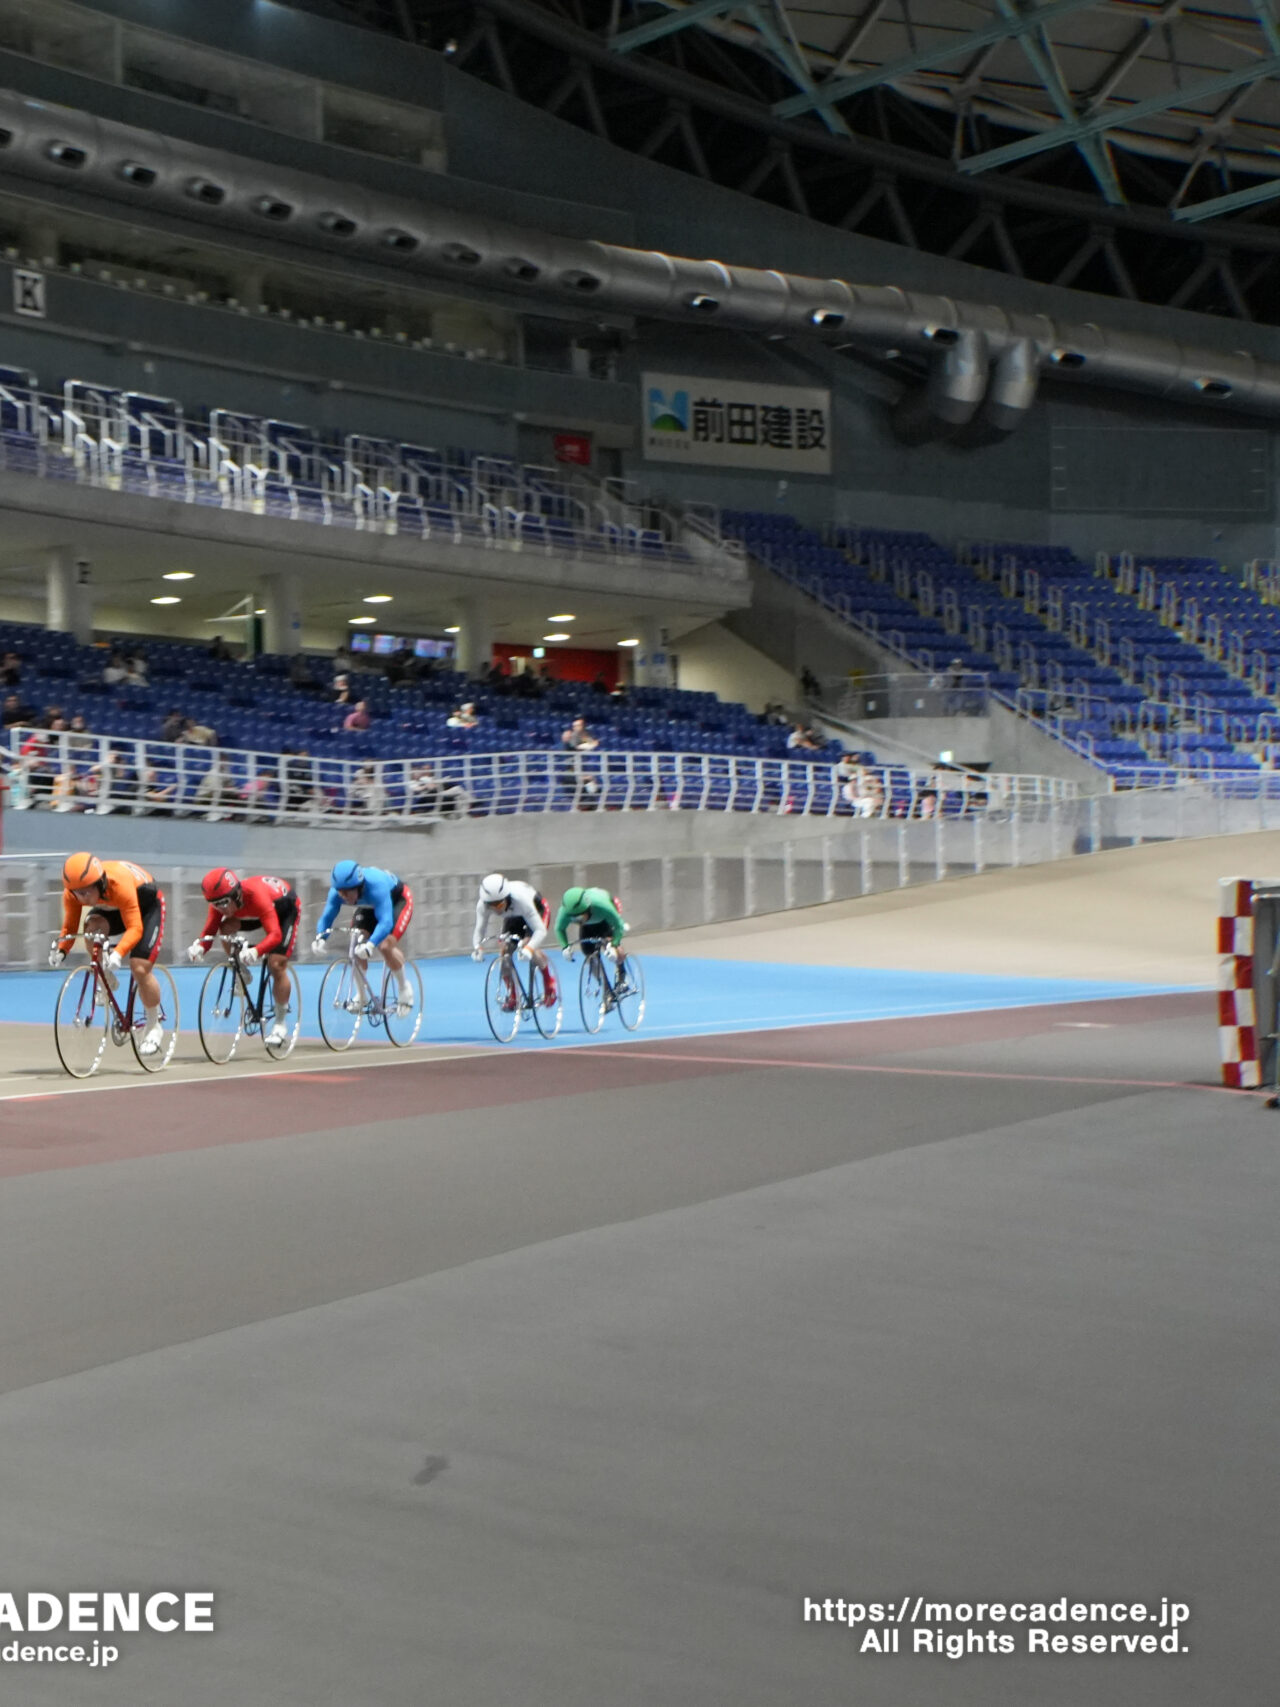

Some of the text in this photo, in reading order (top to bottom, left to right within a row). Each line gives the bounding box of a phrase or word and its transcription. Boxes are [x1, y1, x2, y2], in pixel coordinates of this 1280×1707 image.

[20, 274, 39, 311] K
[692, 397, 827, 450] 前田建設
